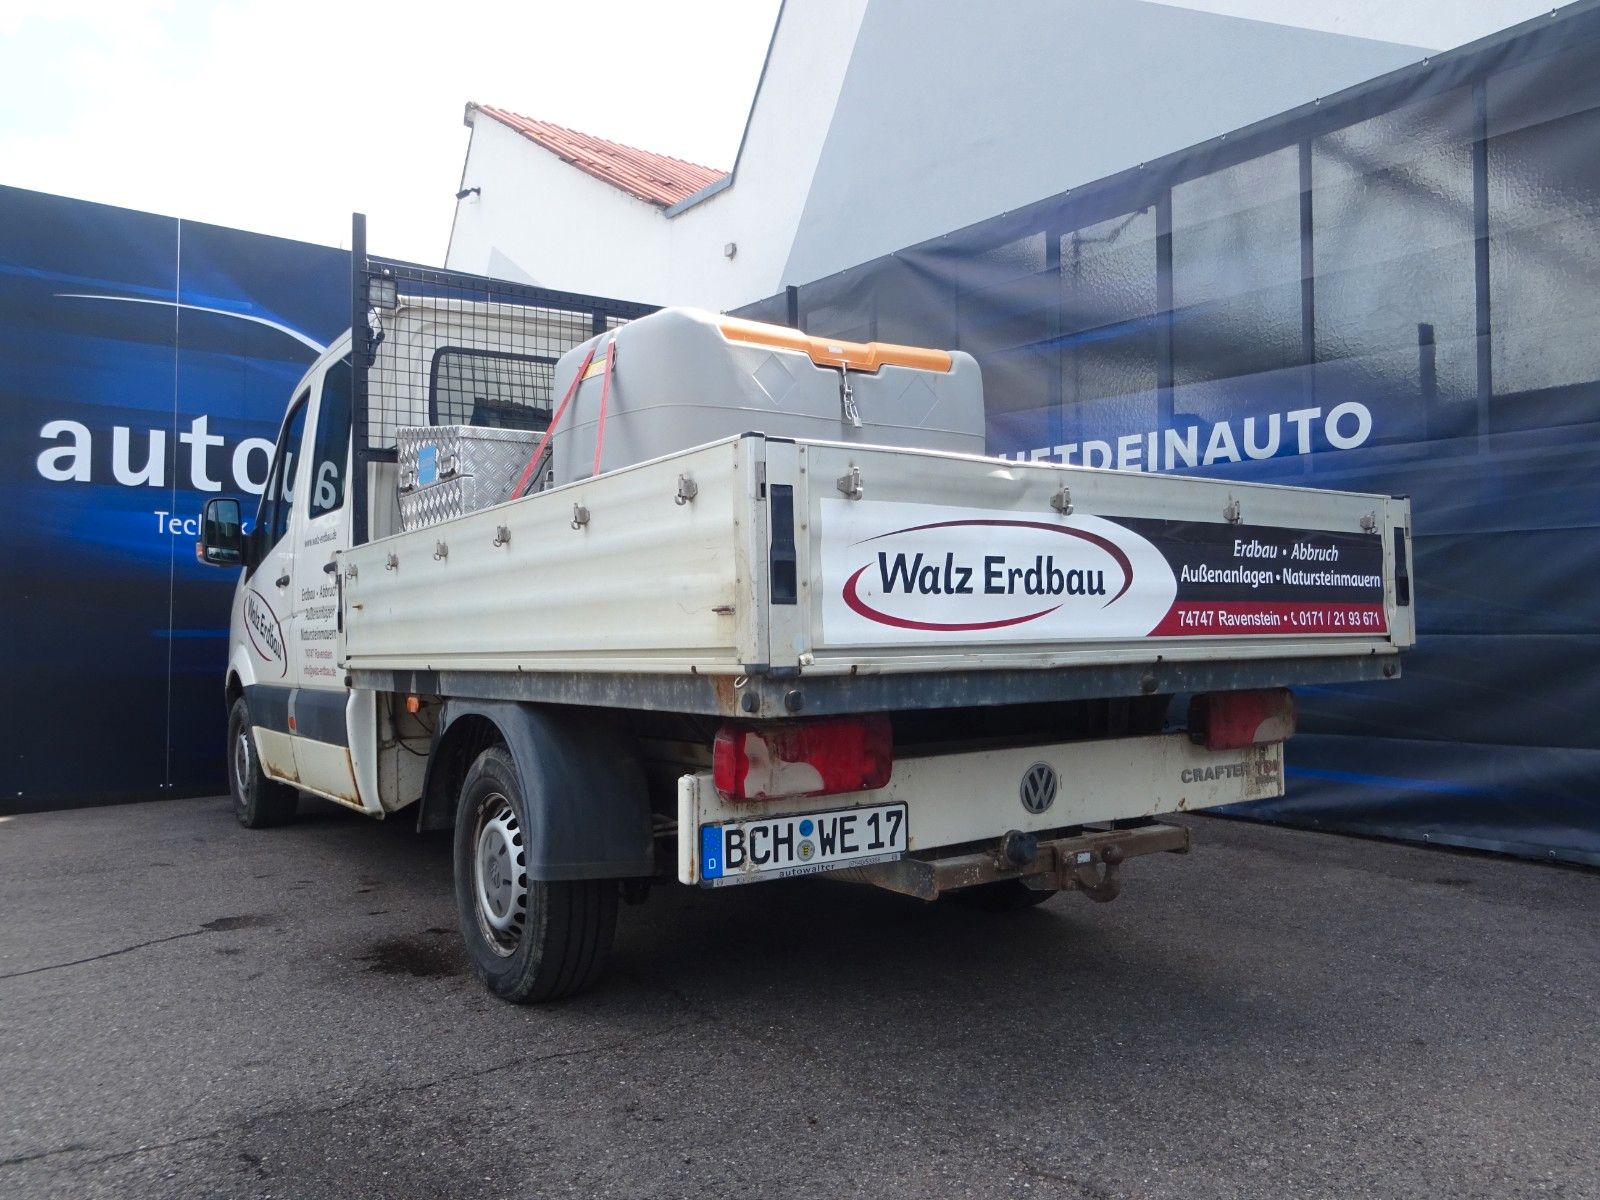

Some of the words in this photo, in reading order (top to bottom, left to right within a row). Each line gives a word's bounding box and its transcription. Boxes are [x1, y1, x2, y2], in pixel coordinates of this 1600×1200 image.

[999, 401, 1373, 473] TDEINAUTO
[1233, 539, 1278, 559] Erdbau
[1291, 543, 1339, 562] Abbruch
[878, 552, 973, 595] Walz
[984, 555, 1106, 596] Erdbau
[1180, 564, 1274, 588] Außenanlagen
[1282, 568, 1381, 588] Natursteinmauern
[1178, 610, 1214, 627] 74747
[1218, 610, 1280, 626] Ravenstein
[1300, 611, 1323, 625] 0171
[1334, 611, 1345, 625] 21
[1349, 611, 1361, 625] 93
[1363, 611, 1379, 626] 671
[1181, 762, 1250, 784] CRAFTER
[725, 823, 794, 869] BCH
[818, 815, 860, 857] WE
[866, 810, 903, 850] 17
[708, 857, 717, 870] D
[779, 864, 836, 878] autowalter
